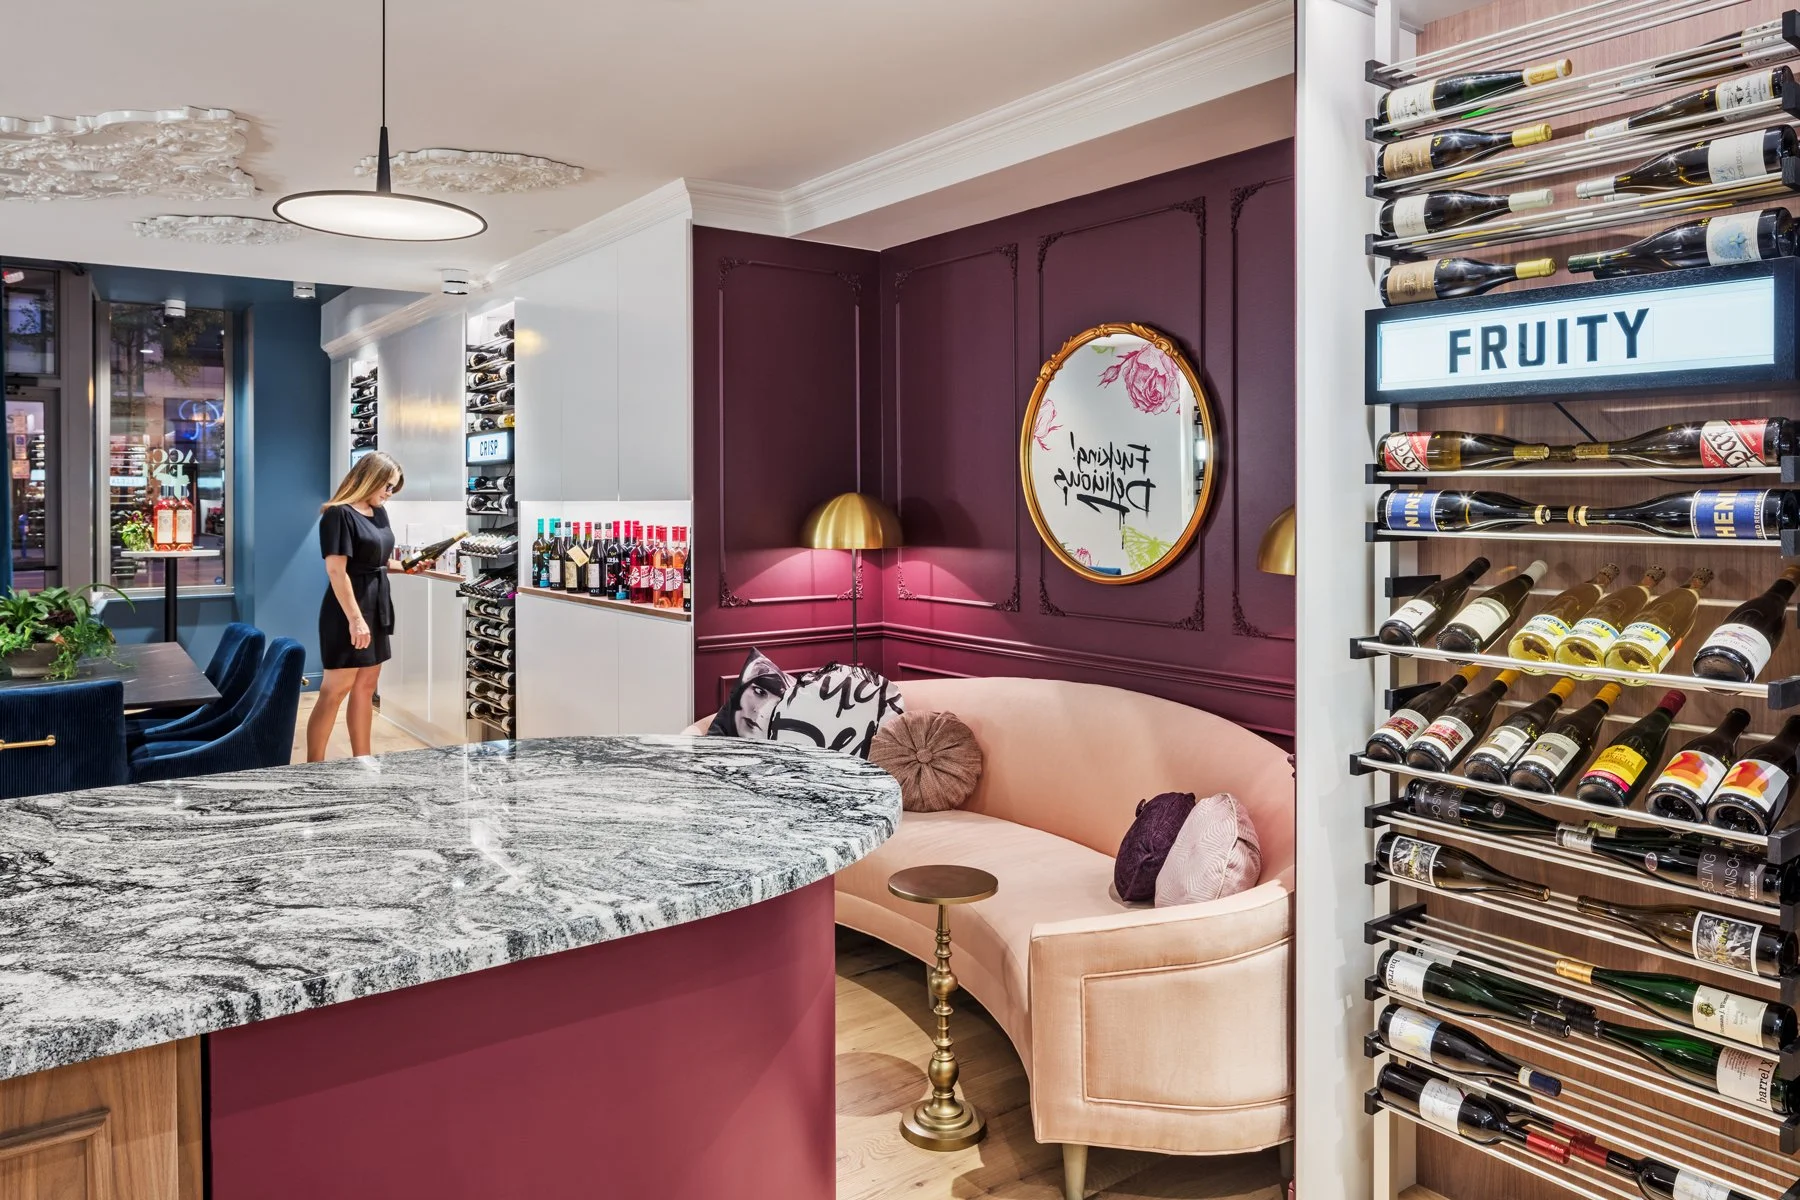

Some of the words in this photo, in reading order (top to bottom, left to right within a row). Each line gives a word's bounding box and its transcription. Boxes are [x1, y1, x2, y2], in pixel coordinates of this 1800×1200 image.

[1448, 308, 1650, 373] FRUITY
[480, 439, 498, 456] CRISP
[1387, 958, 1400, 987] barrel
[1760, 1059, 1775, 1068] X
[1756, 1067, 1770, 1104] barrel
